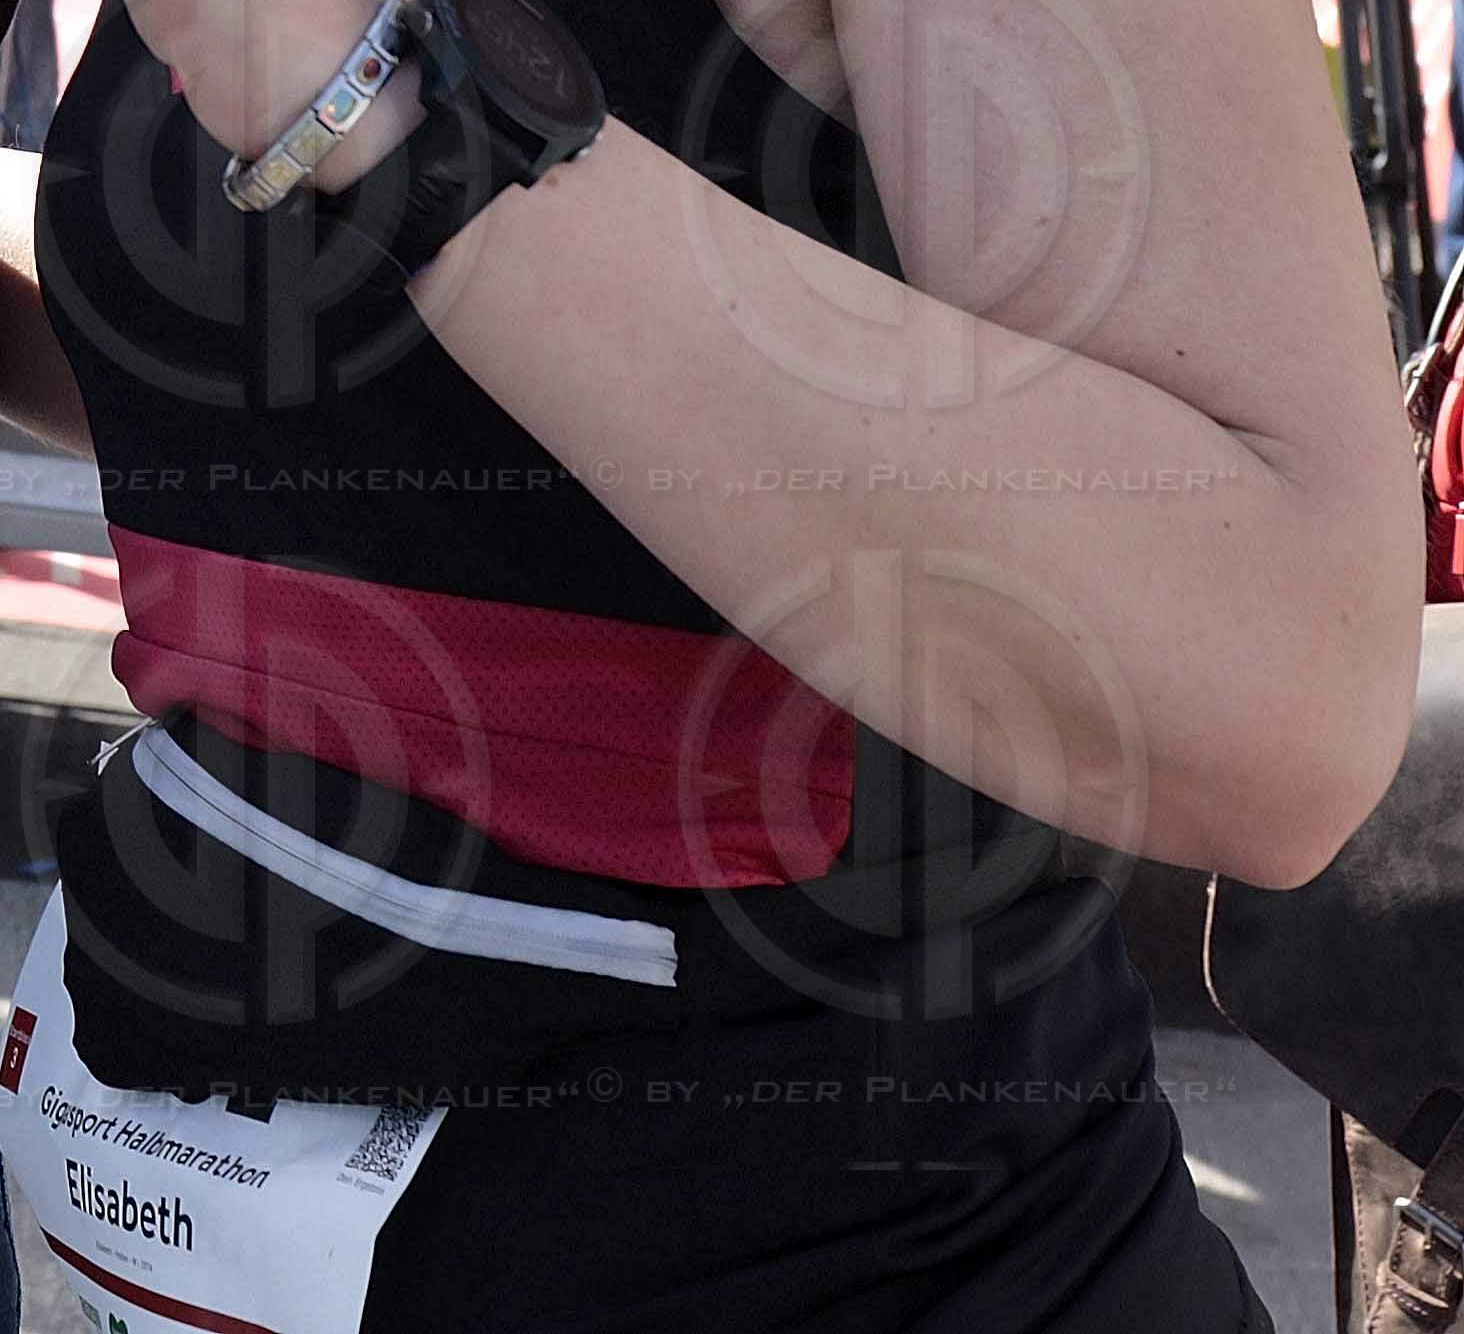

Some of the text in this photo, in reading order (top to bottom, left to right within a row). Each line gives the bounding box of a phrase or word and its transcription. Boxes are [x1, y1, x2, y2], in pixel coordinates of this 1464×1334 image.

[10, 1046, 19, 1069] 3
[113, 1120, 272, 1189] Halbmarathon
[65, 1157, 194, 1252] Elisabeth
